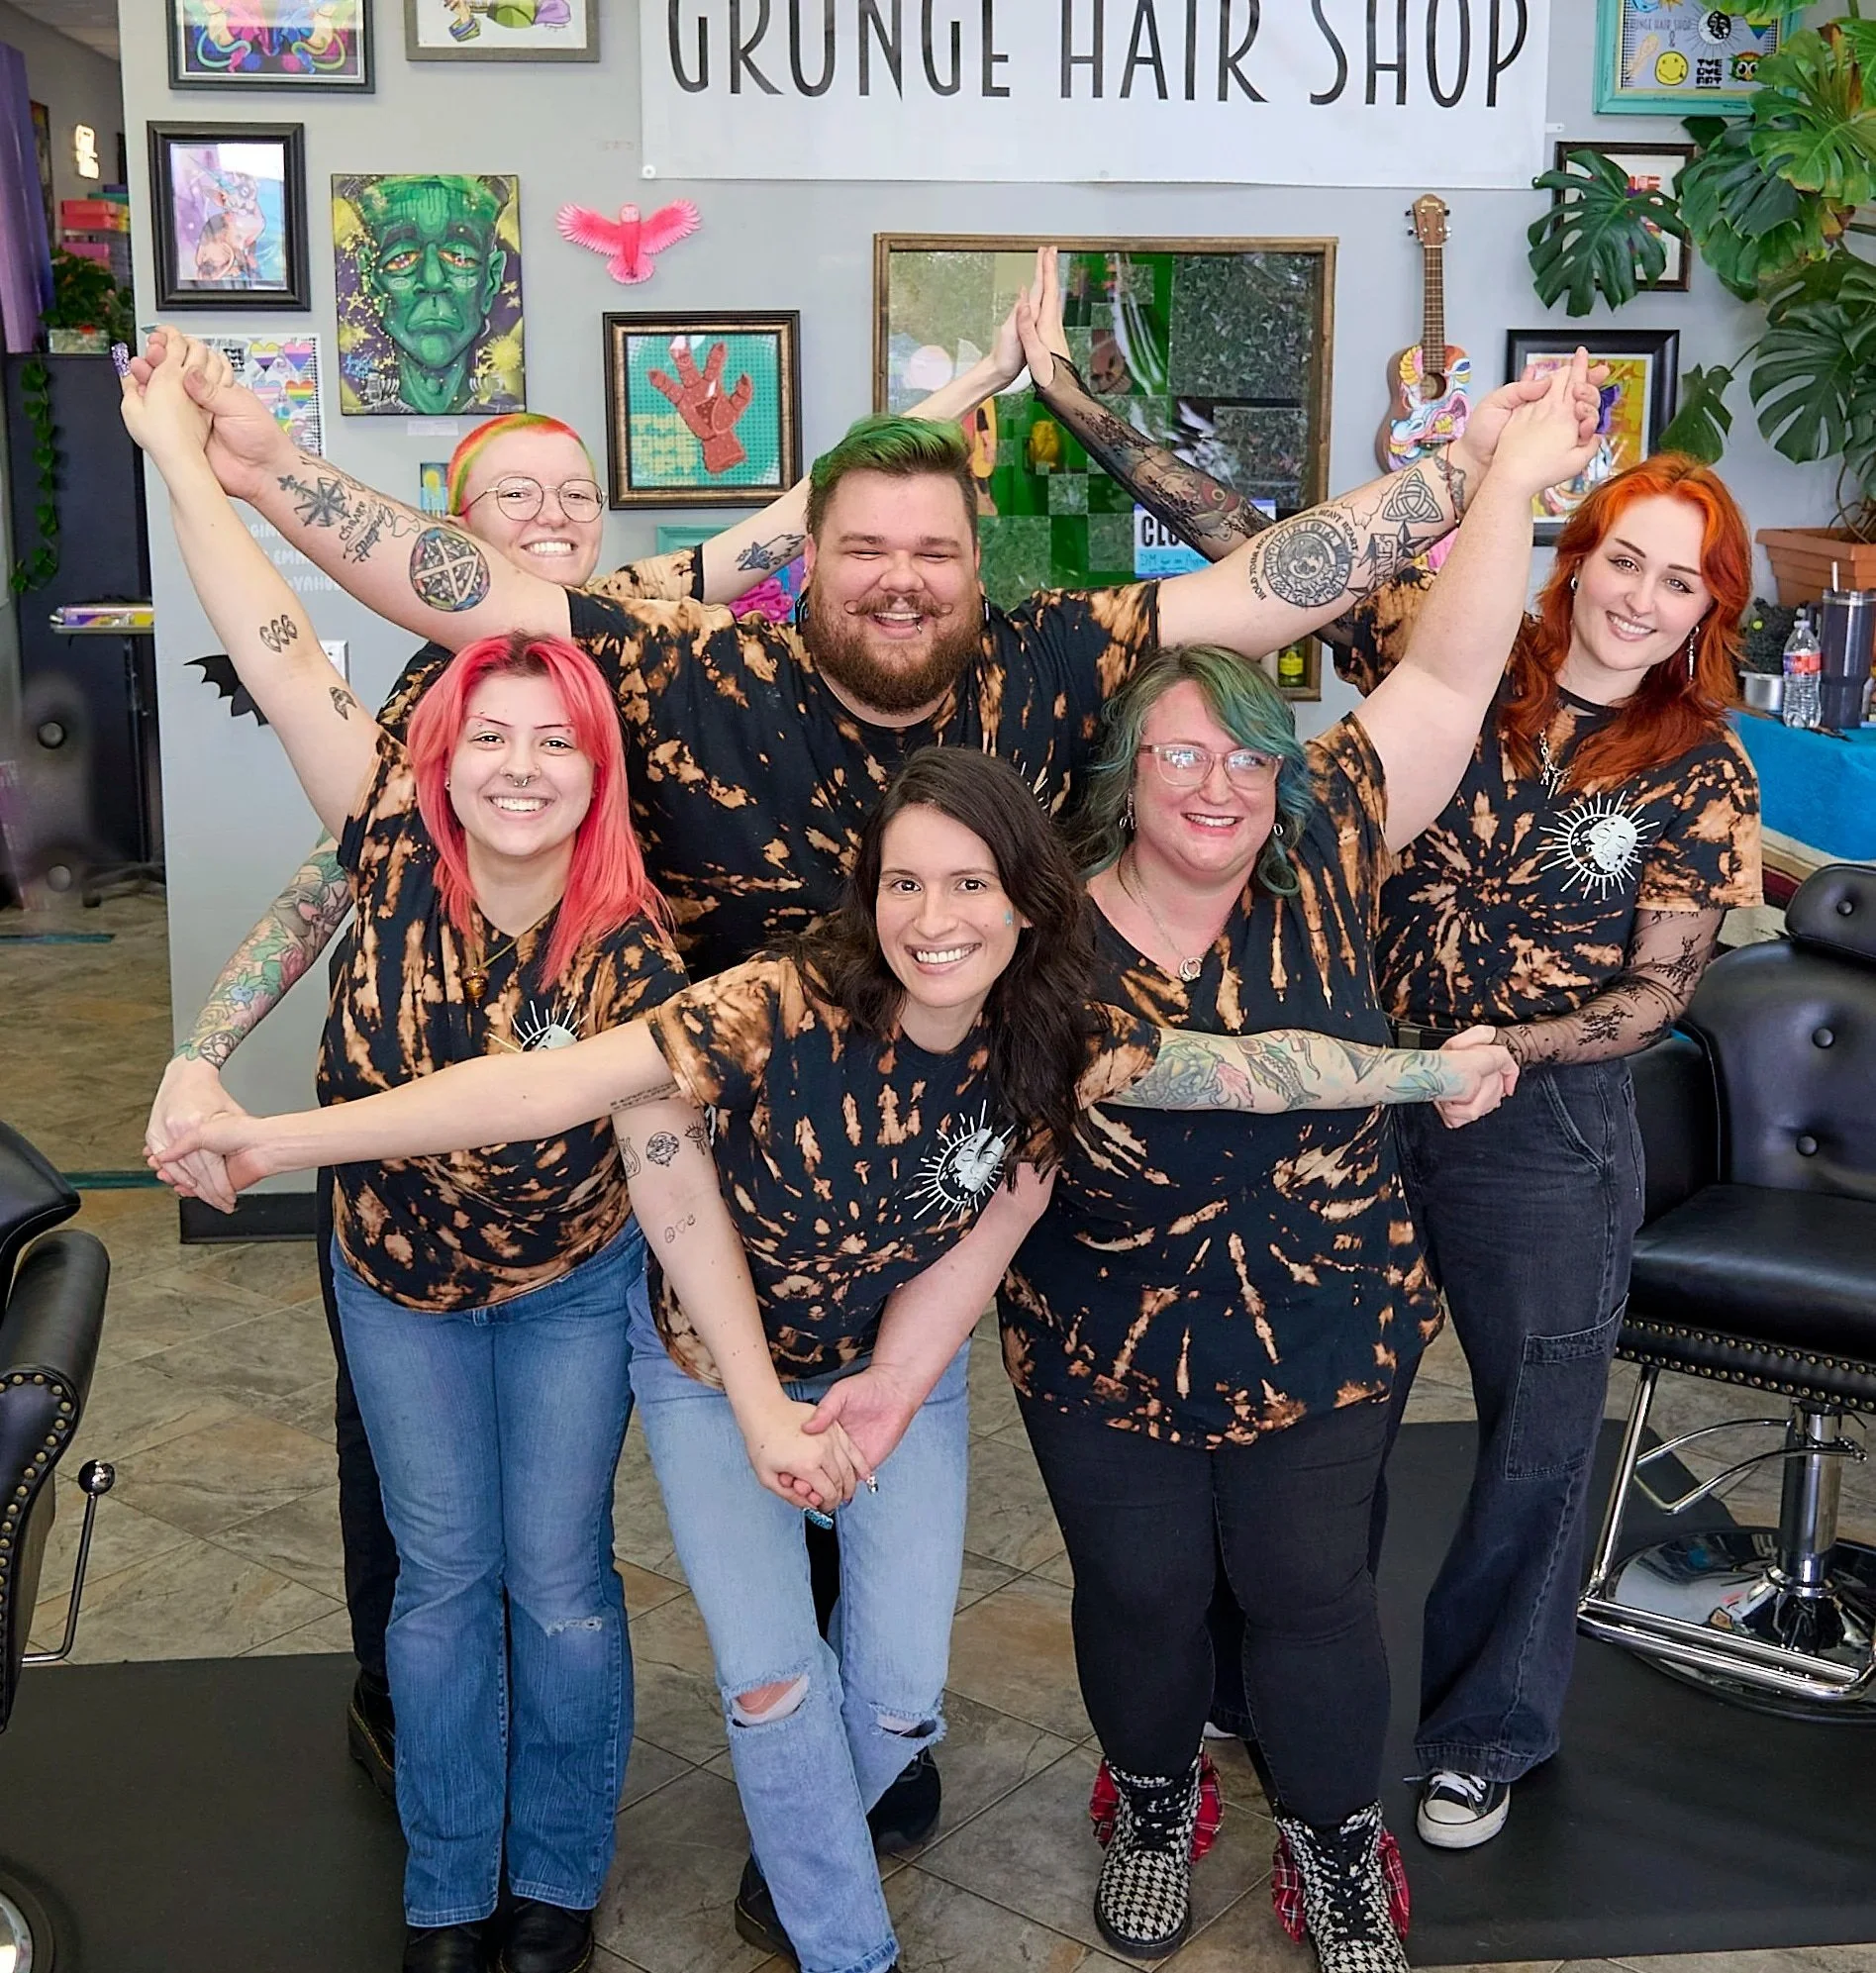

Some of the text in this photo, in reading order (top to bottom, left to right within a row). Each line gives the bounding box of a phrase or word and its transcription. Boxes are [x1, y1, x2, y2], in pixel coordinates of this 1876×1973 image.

[668, 0, 1528, 108] GRUNGE HAIR SHOP
